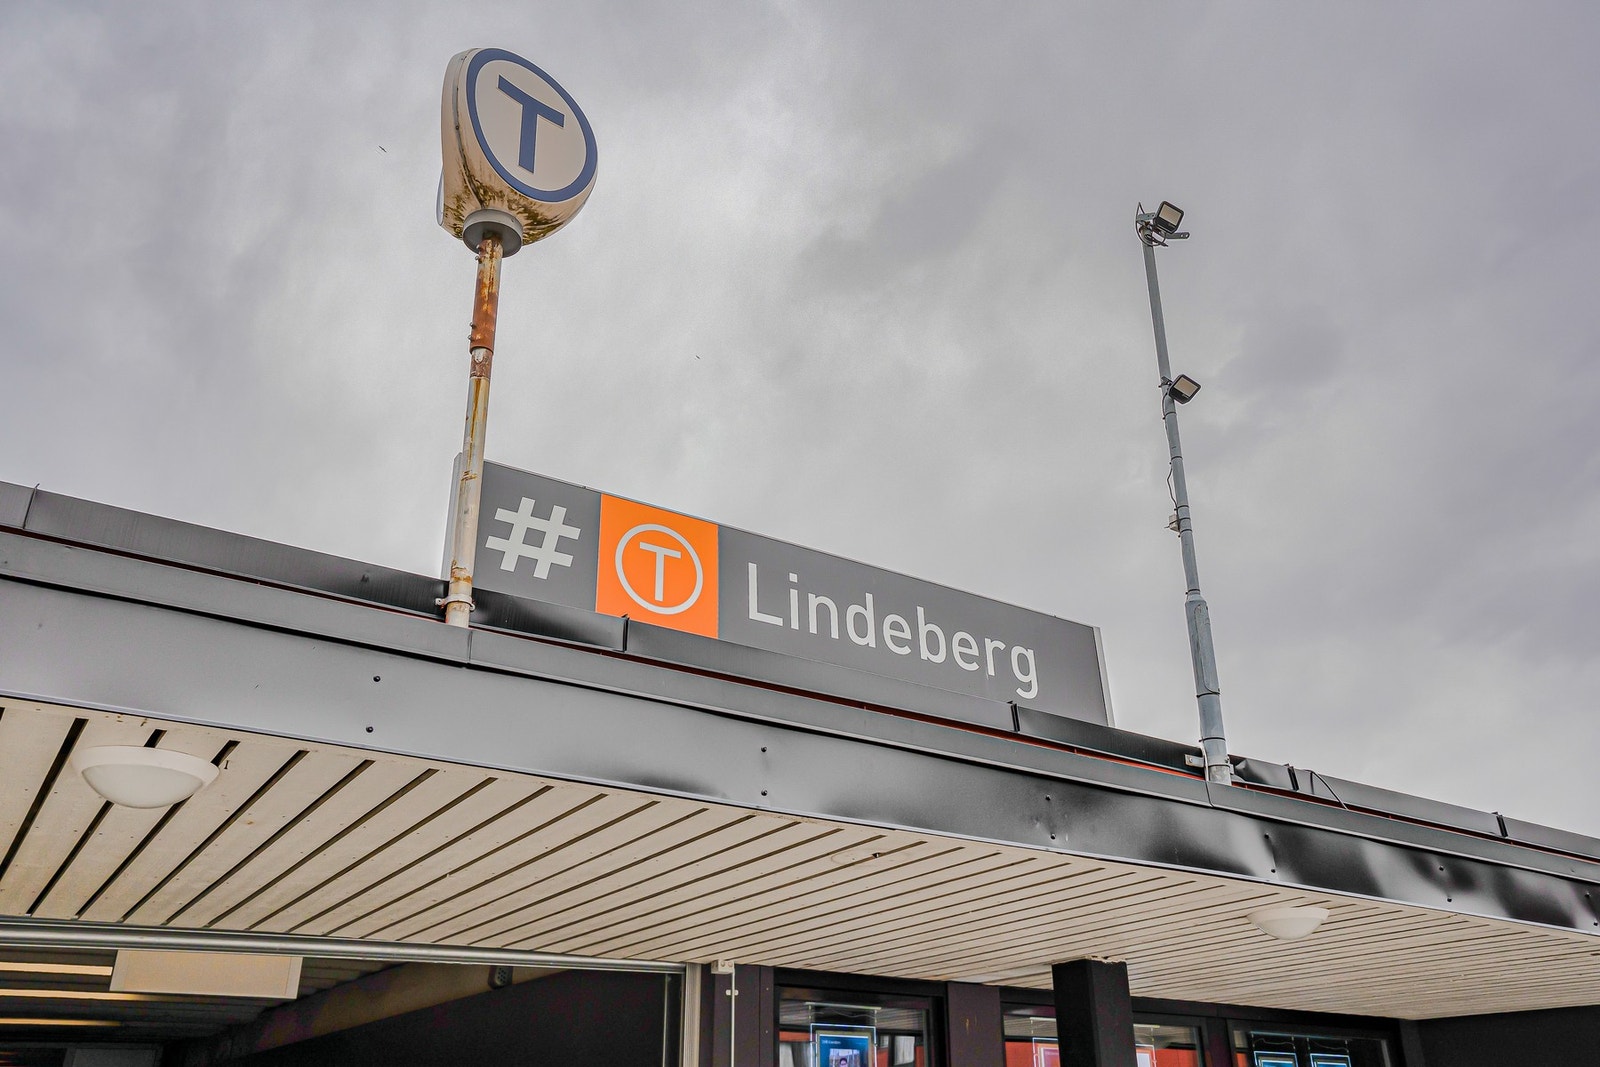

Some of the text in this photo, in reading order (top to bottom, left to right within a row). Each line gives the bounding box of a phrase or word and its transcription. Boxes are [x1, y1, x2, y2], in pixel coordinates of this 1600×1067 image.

[498, 74, 565, 174] T
[639, 541, 682, 602] T
[748, 562, 1039, 700] Lindeberg
